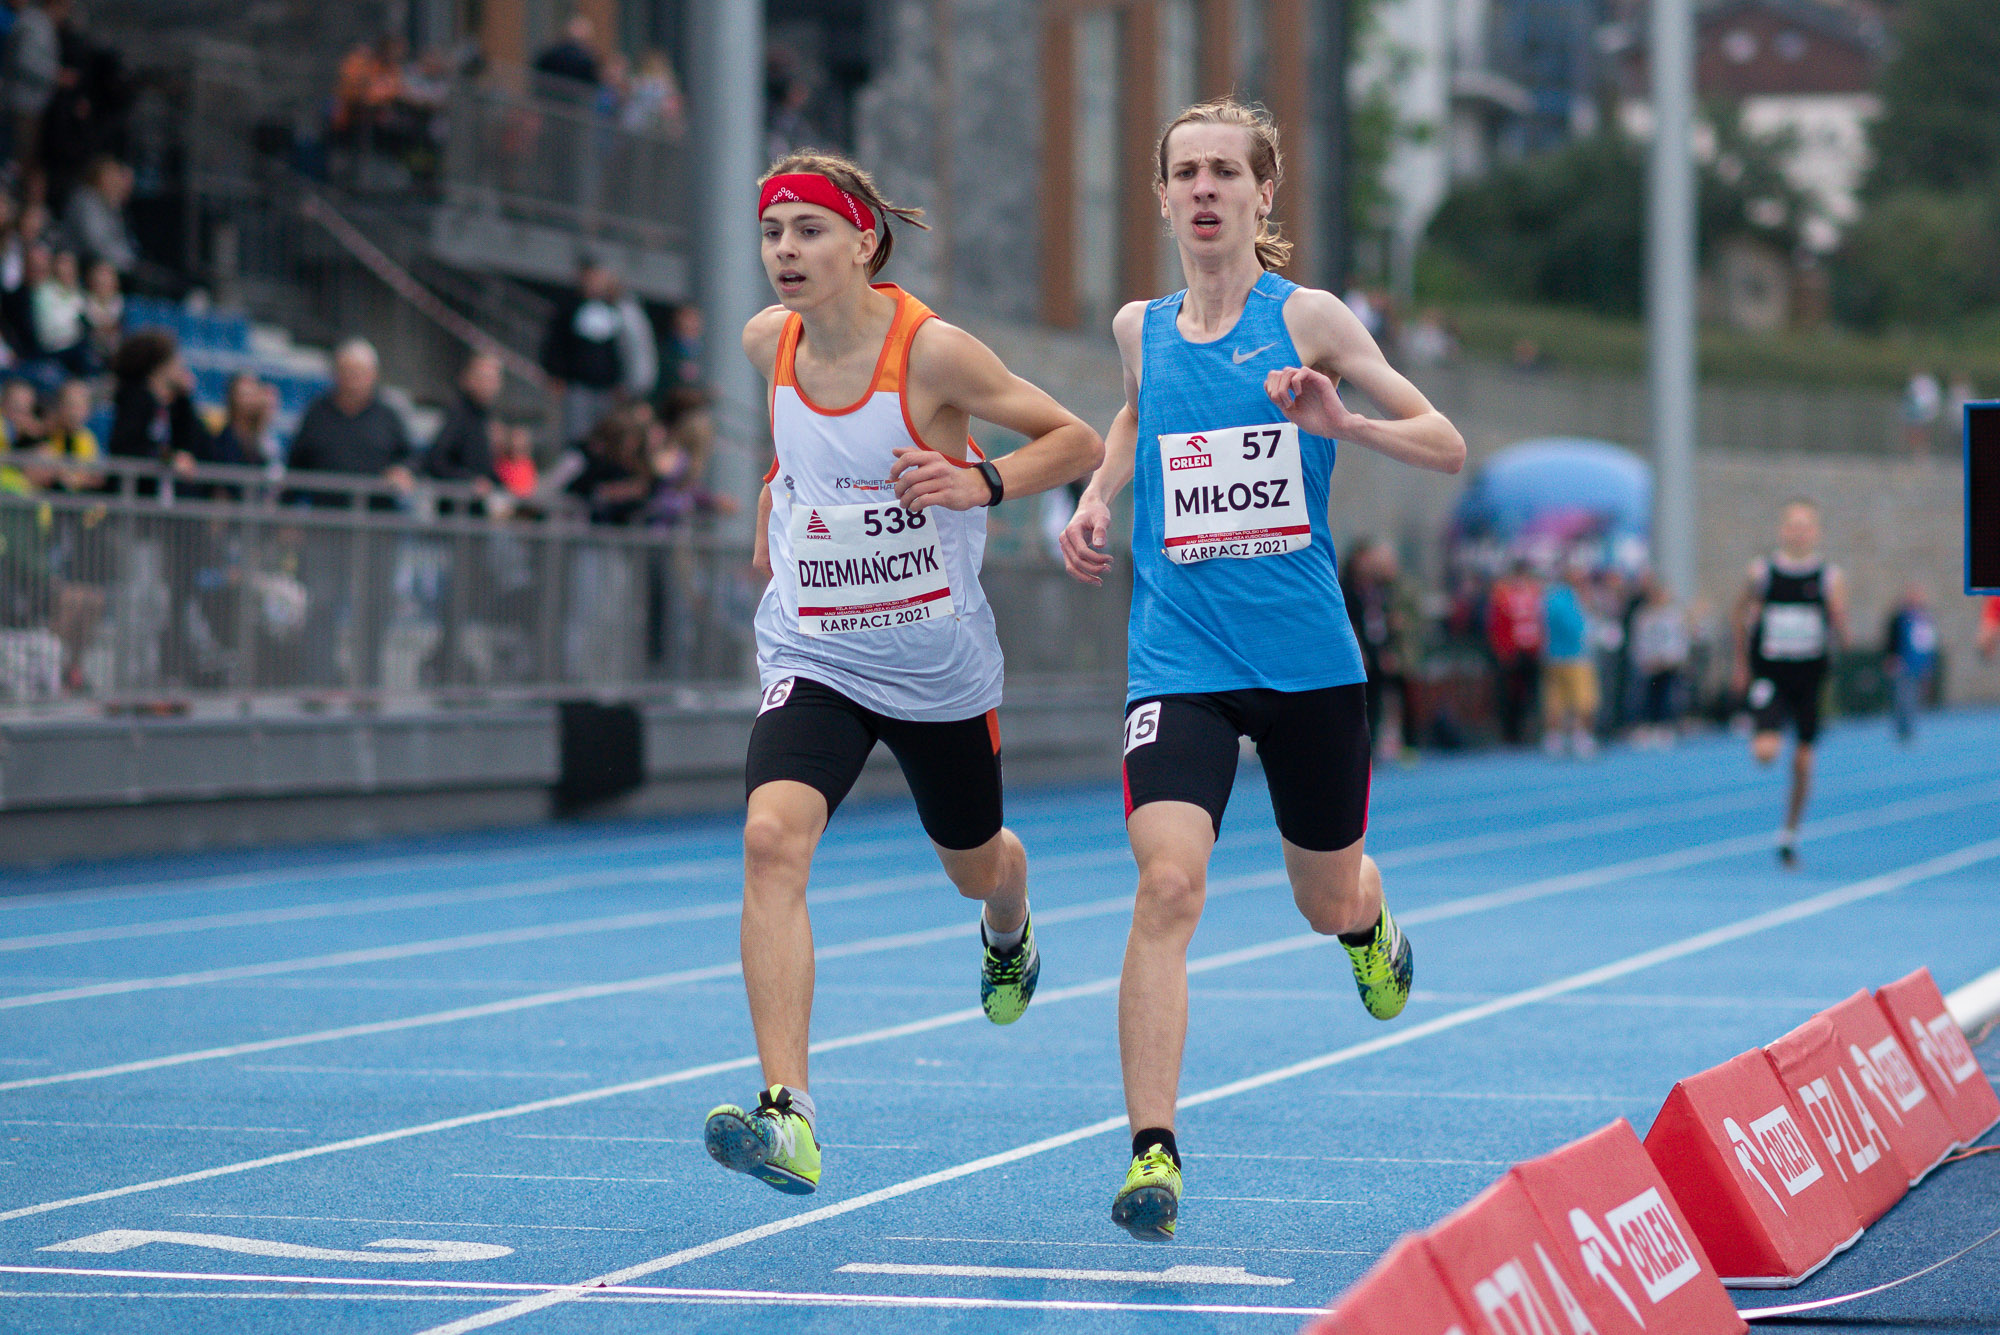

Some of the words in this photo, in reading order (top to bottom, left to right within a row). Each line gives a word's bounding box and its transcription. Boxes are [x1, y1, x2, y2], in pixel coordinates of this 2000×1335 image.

[1242, 429, 1282, 460] 57
[1171, 455, 1211, 470] ORLEN
[836, 477, 851, 489] KS
[1174, 478, 1290, 517] MIŁOSZ
[863, 506, 927, 537] 538
[798, 545, 939, 587] DZIEMIAŃCZYK
[1181, 543, 1250, 561] KARPACZ
[1254, 540, 1288, 555] 2021
[820, 613, 892, 632] KARPACZ
[895, 606, 931, 625] 2021
[1761, 1117, 1816, 1184] ORLEN
[1619, 1203, 1691, 1286] ORLEN
